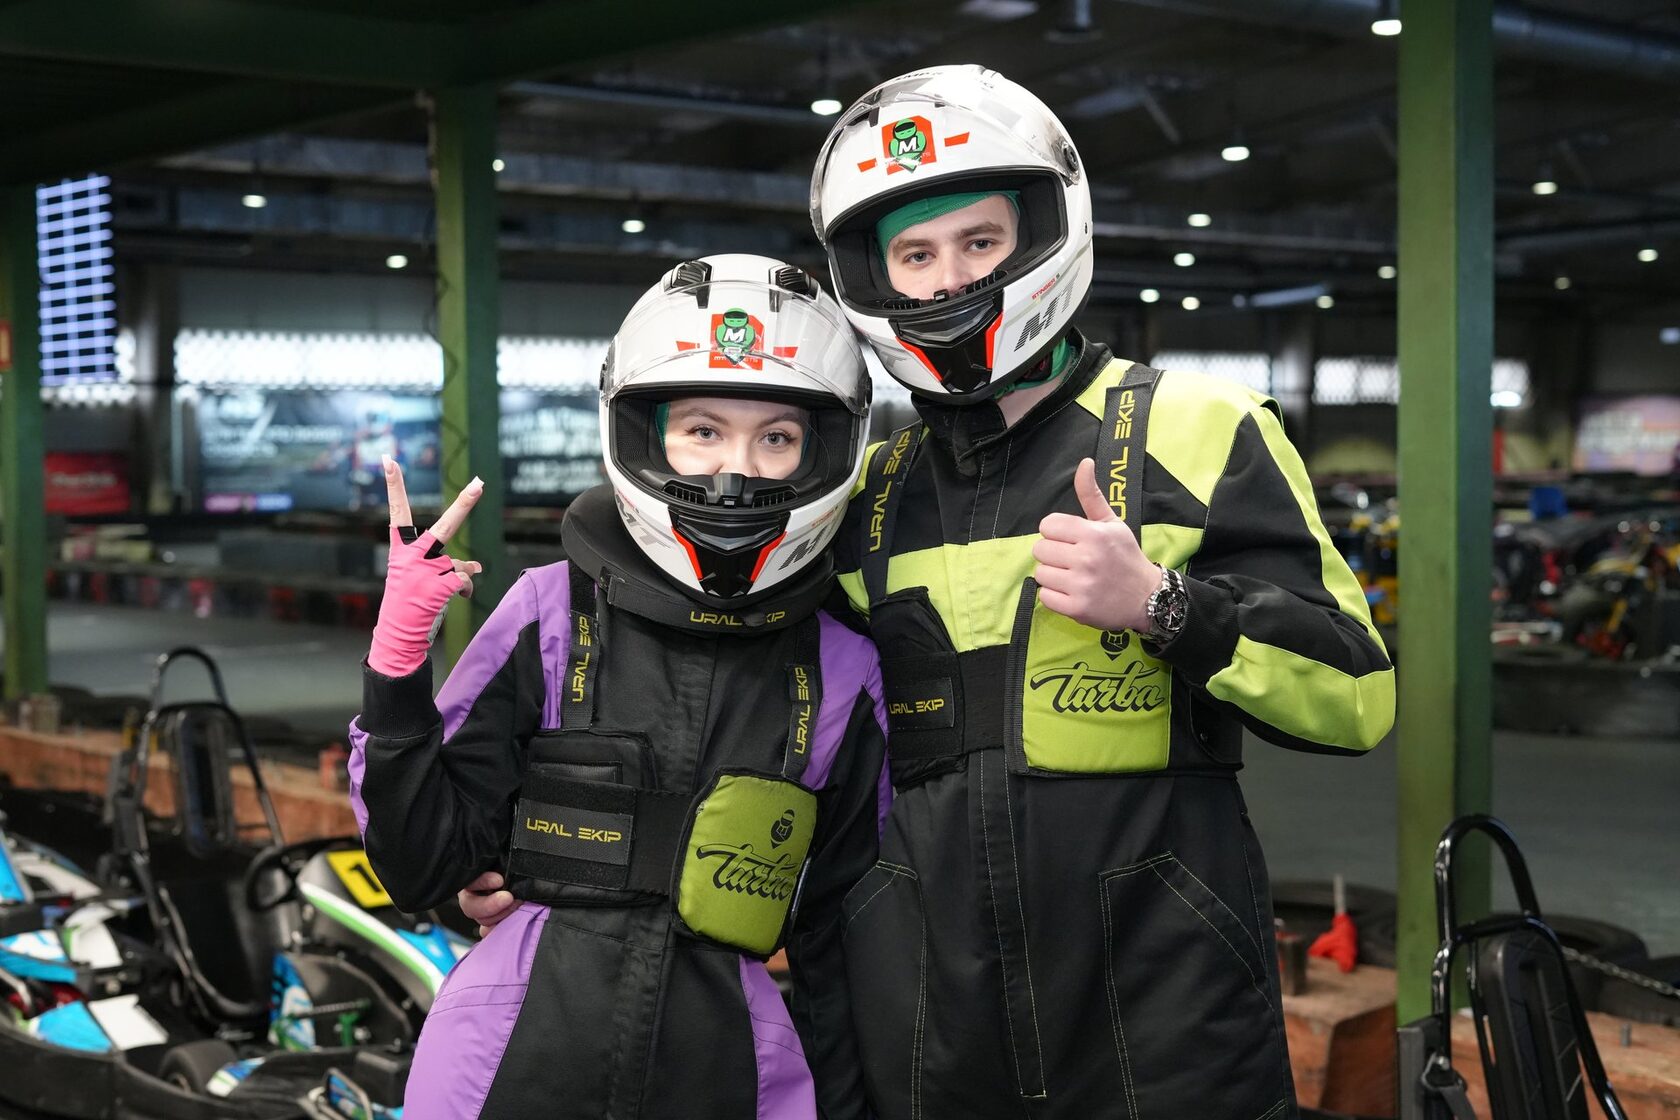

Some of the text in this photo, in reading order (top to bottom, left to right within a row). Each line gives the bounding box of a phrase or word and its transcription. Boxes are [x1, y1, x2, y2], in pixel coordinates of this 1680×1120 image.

[869, 480, 892, 552] URAL
[883, 430, 911, 475] EKIP
[1109, 389, 1135, 521] URAL EKIP
[572, 615, 591, 702] URAL EKIP
[690, 611, 743, 625] URAL
[795, 667, 811, 754] URAL EKIP
[889, 698, 945, 715] URAL EKIP
[526, 817, 622, 842] URAL EKIP
